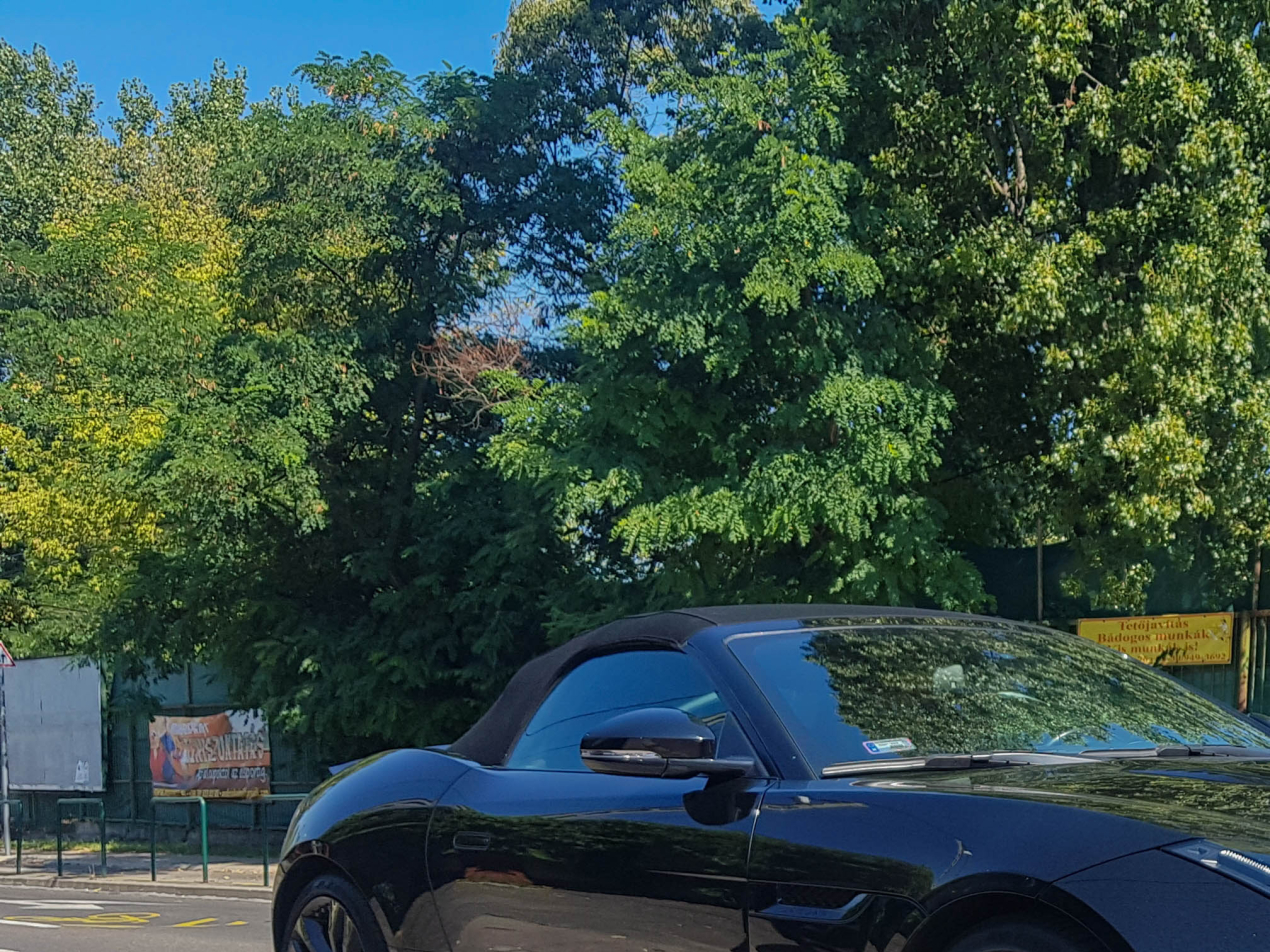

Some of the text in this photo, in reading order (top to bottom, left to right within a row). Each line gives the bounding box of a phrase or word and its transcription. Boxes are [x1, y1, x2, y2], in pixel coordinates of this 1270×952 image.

[1118, 618, 1189, 631] Tetőjavítás
[1098, 629, 1210, 644] Bádogos munkák
